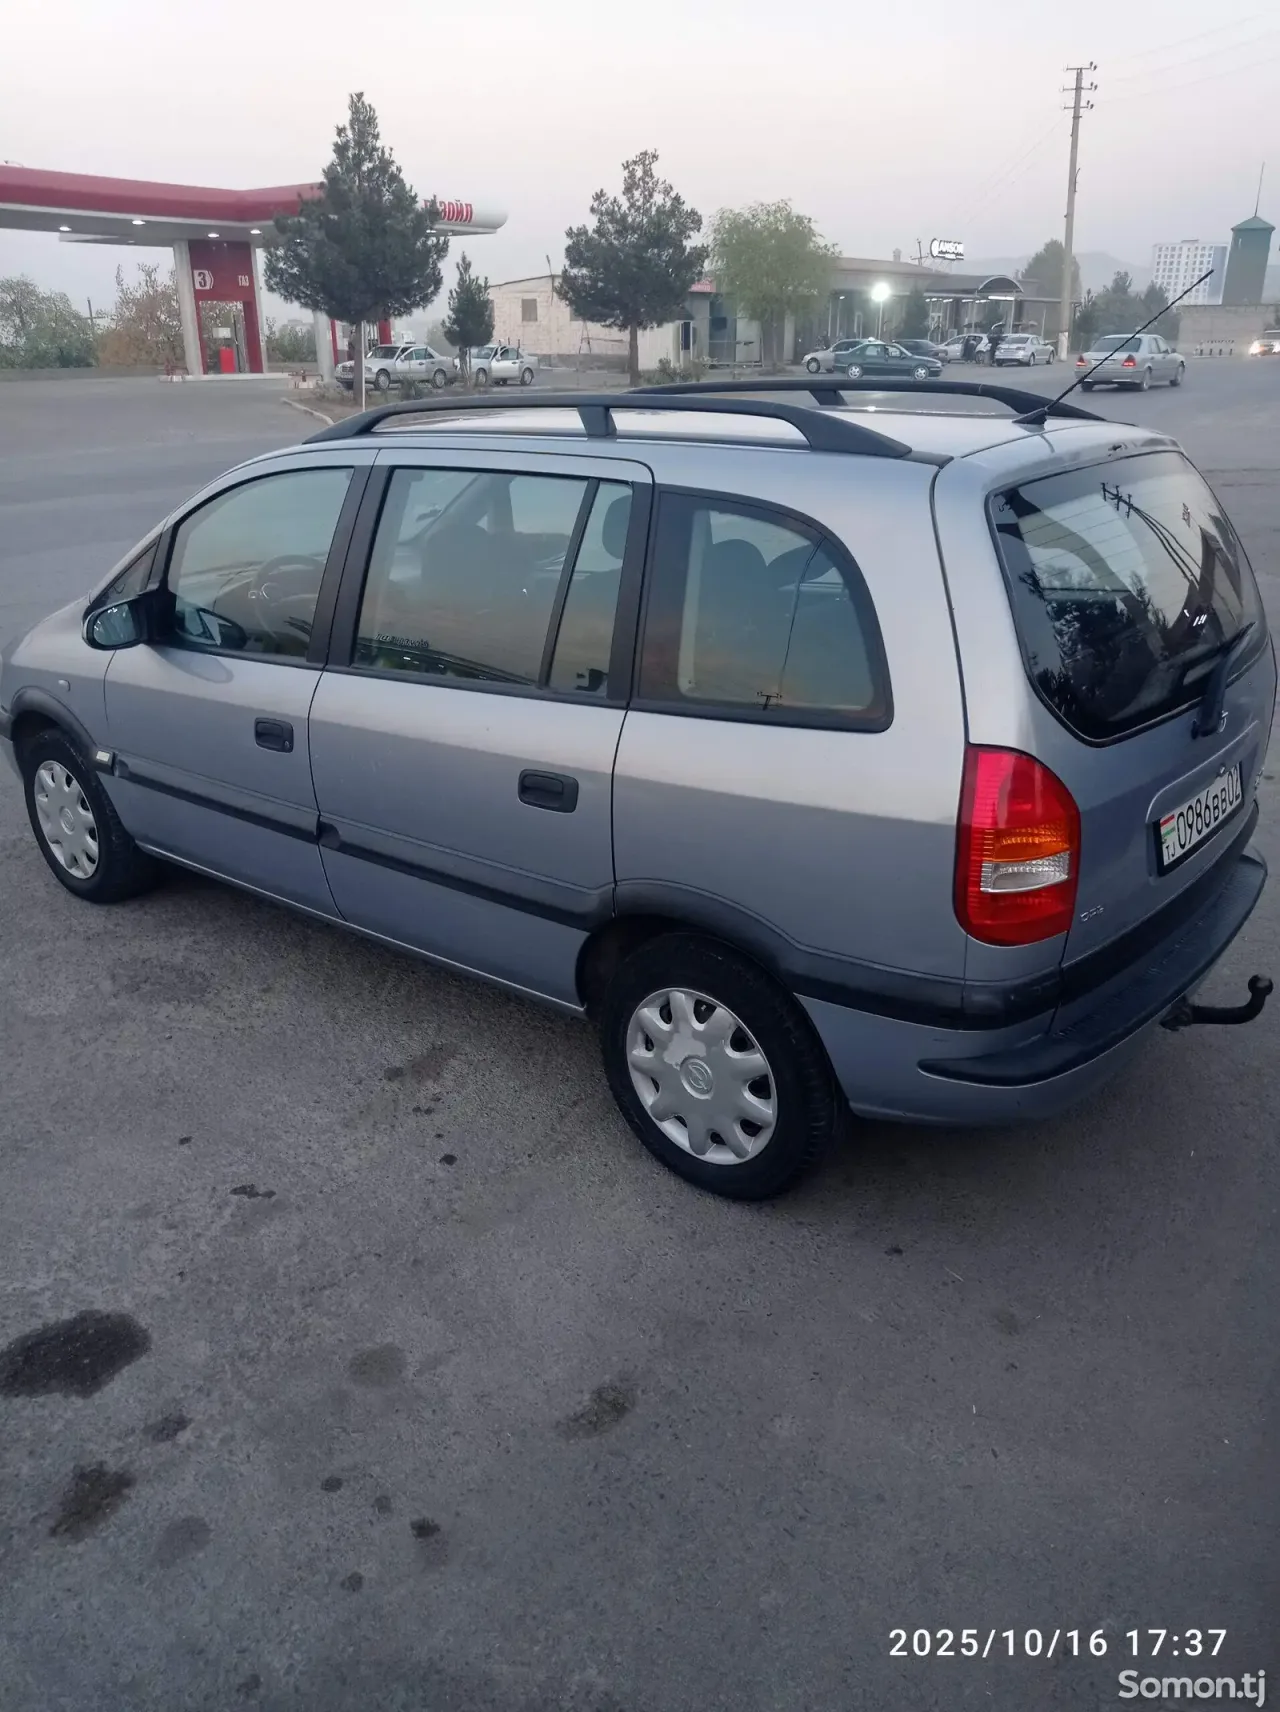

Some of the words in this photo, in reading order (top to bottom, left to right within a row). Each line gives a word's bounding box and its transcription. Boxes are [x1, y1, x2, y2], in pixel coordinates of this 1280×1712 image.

[198, 271, 207, 288] 3
[238, 275, 250, 287] ГАЗ
[1165, 842, 1176, 860] TJ
